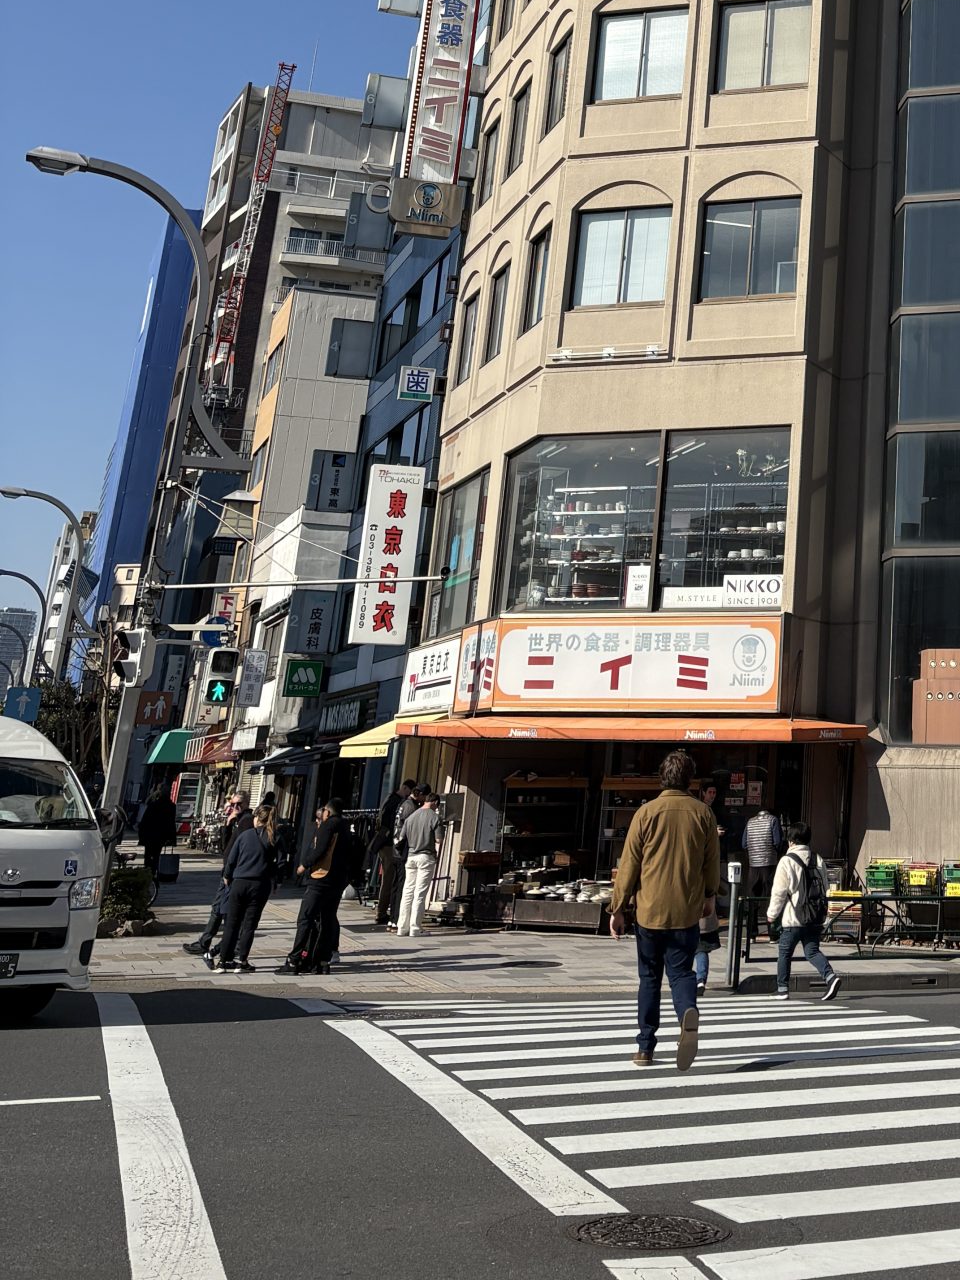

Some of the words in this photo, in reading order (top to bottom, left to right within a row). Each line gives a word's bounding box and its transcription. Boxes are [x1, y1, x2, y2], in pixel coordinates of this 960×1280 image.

[417, 58, 461, 163] ニイミ
[406, 207, 444, 225] Niimi
[407, 370, 430, 392] 歯
[372, 489, 407, 632] 東京白衣
[726, 578, 781, 593] NIKKO
[677, 594, 717, 602] M.STYLE
[727, 597, 755, 605] SINCE
[306, 607, 324, 650] 皮膚科
[524, 654, 709, 691] ニイミ
[729, 673, 765, 687] Niimi
[508, 728, 531, 738] Niimi
[684, 729, 707, 739] Niimi
